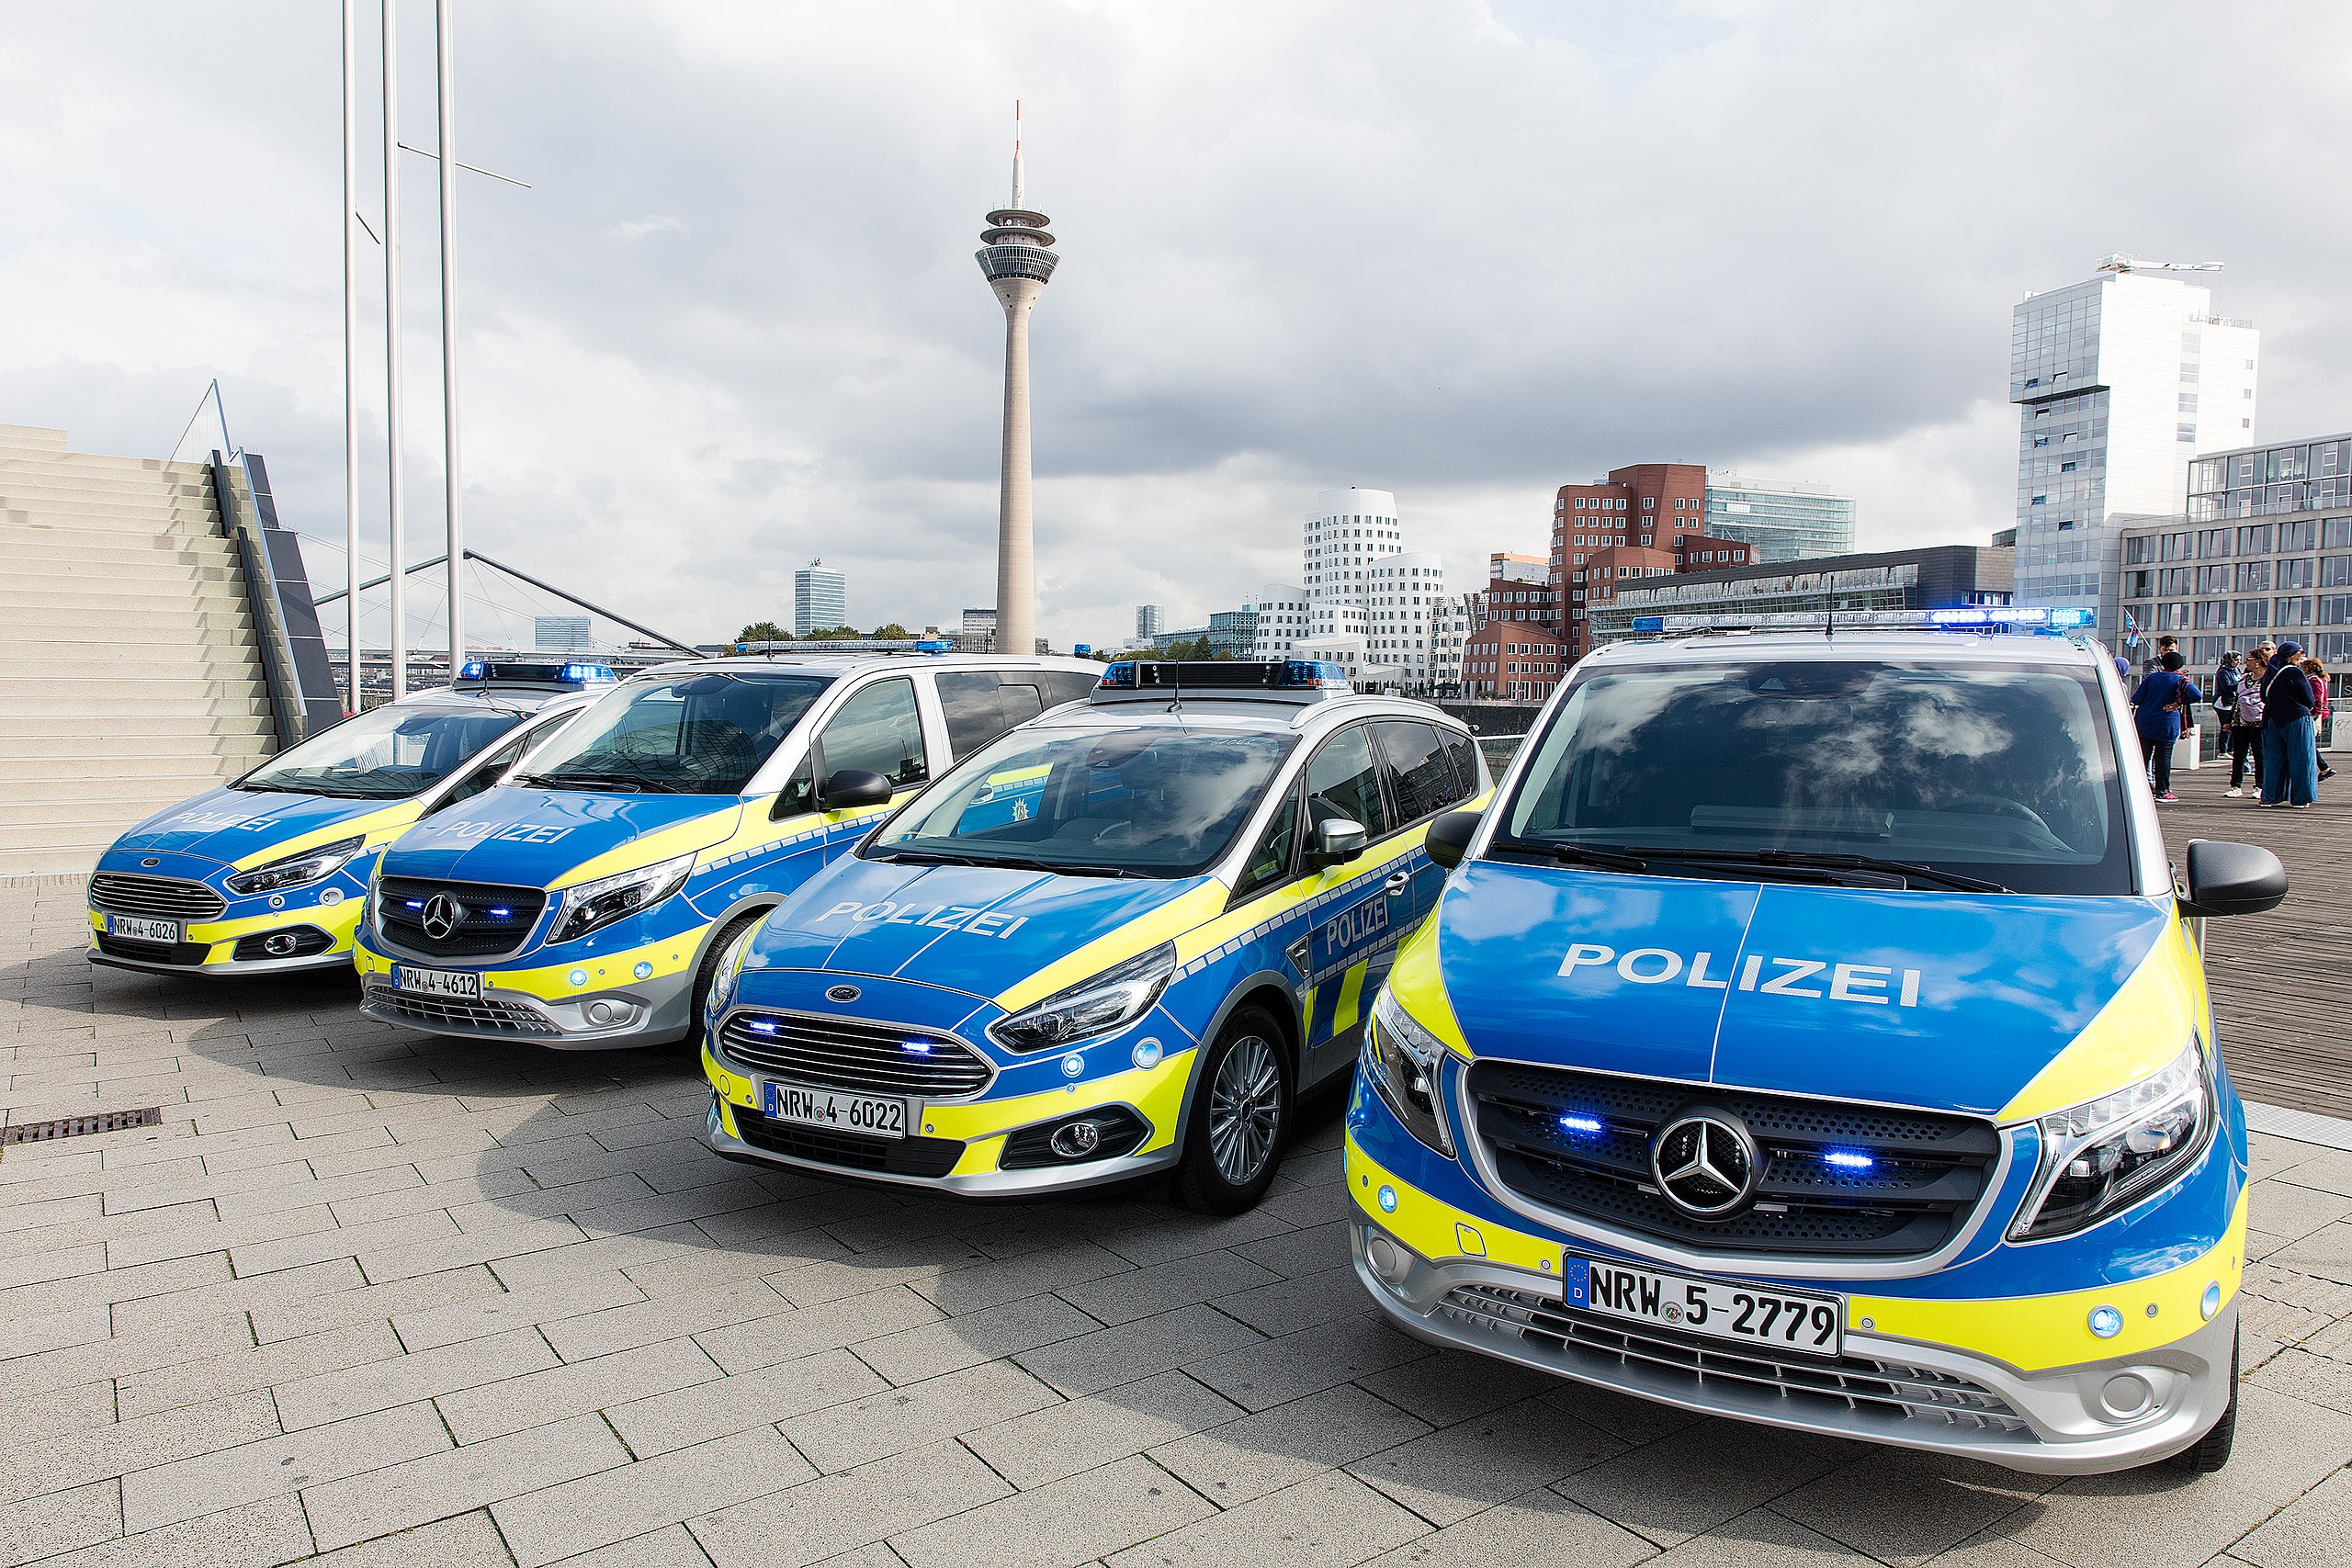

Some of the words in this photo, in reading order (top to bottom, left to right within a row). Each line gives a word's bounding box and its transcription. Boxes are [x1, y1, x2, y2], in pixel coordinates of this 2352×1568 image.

[175, 811, 282, 832] POLIZEI
[436, 820, 576, 844] POLIZEI
[114, 917, 132, 936] NRW
[138, 920, 175, 941] 4-6026
[815, 901, 1030, 939] POLIZEI
[1327, 896, 1388, 955] POLIZEI
[399, 967, 422, 990] NRW
[428, 972, 476, 996] 4-4612
[1556, 942, 1921, 1007] POLIZEI
[768, 1103, 775, 1111] D
[776, 1088, 814, 1120] NRW
[826, 1096, 902, 1132] 4-6022
[1573, 1286, 1583, 1299] D
[1589, 1265, 1661, 1317] NRW
[1685, 1284, 1836, 1346] 5-2779
